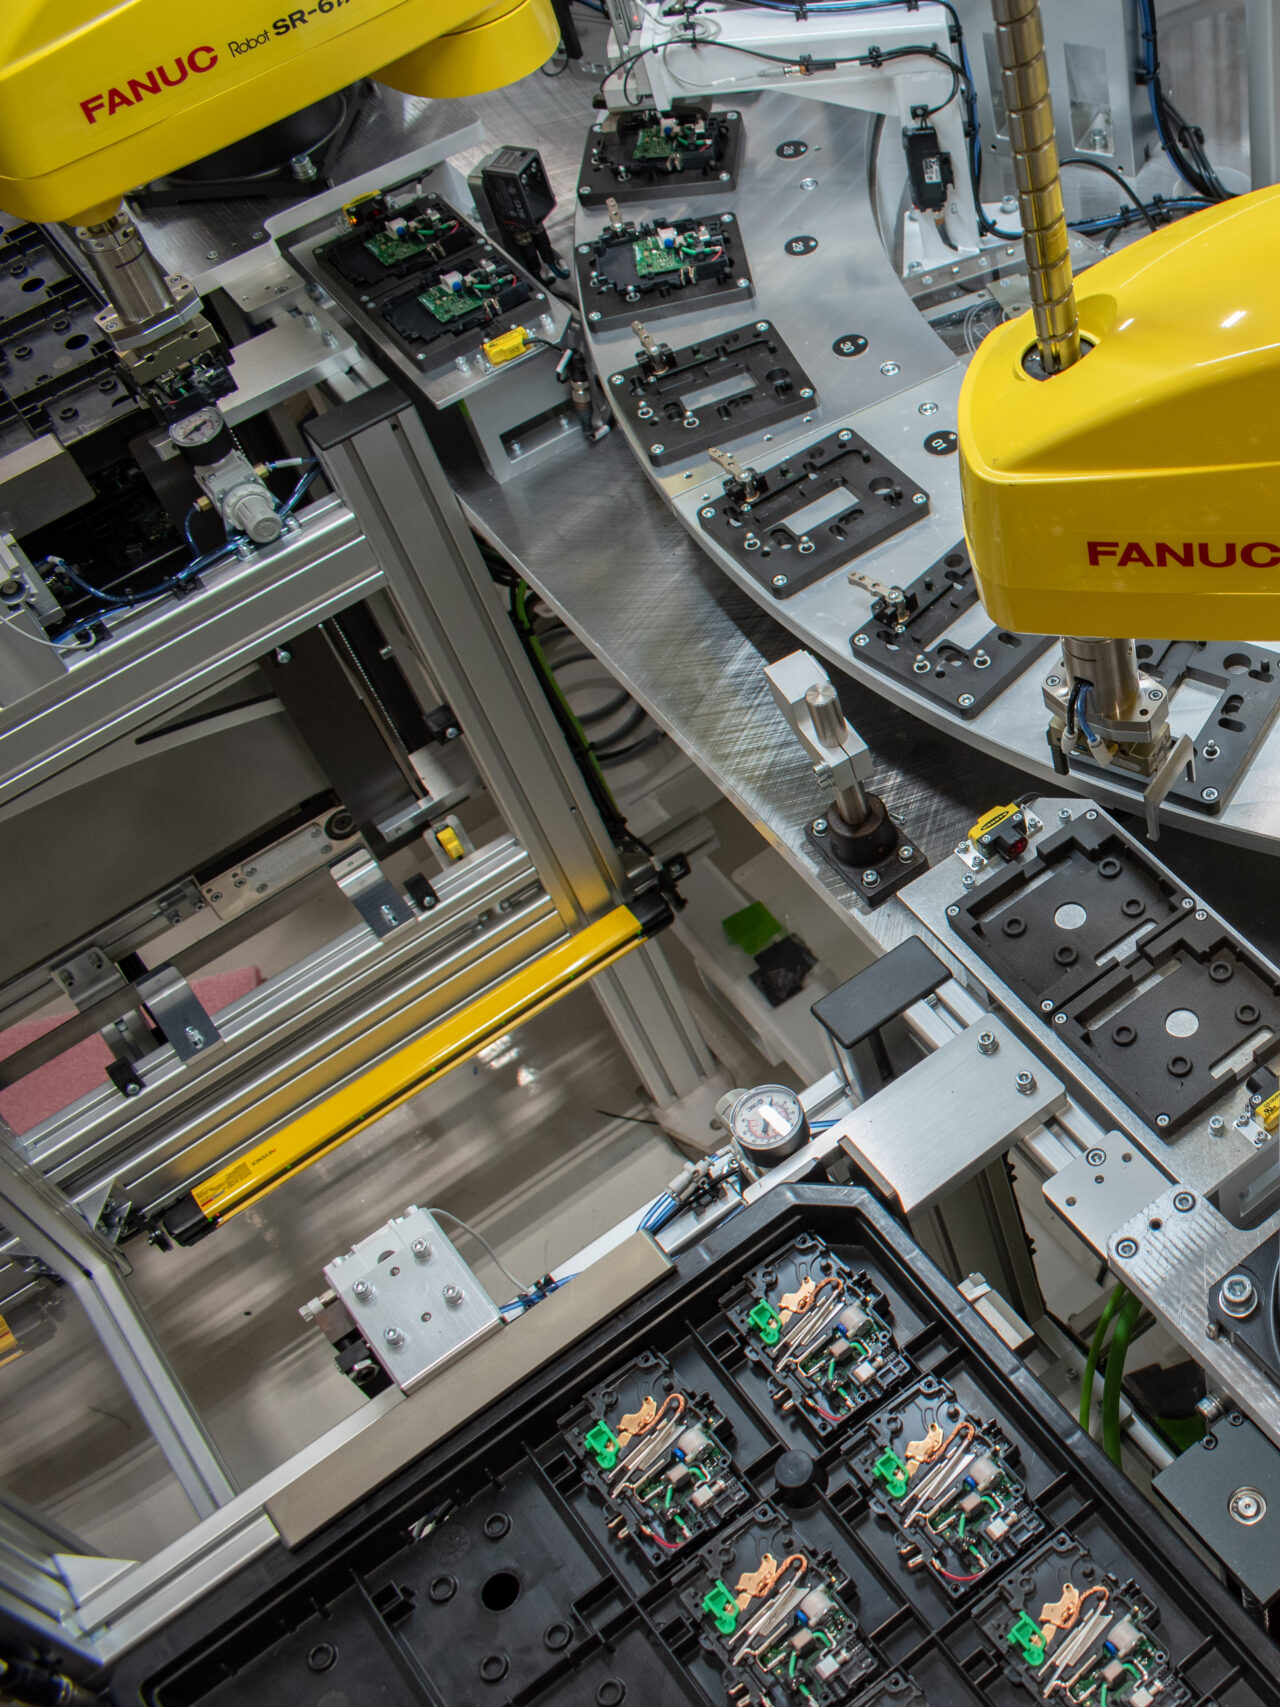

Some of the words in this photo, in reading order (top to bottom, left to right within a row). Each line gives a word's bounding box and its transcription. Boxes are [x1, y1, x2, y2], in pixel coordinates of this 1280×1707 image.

[79, 45, 219, 125] FANUC
[227, 29, 271, 58] Robot
[840, 341, 855, 353] 30
[931, 438, 948, 451] 01
